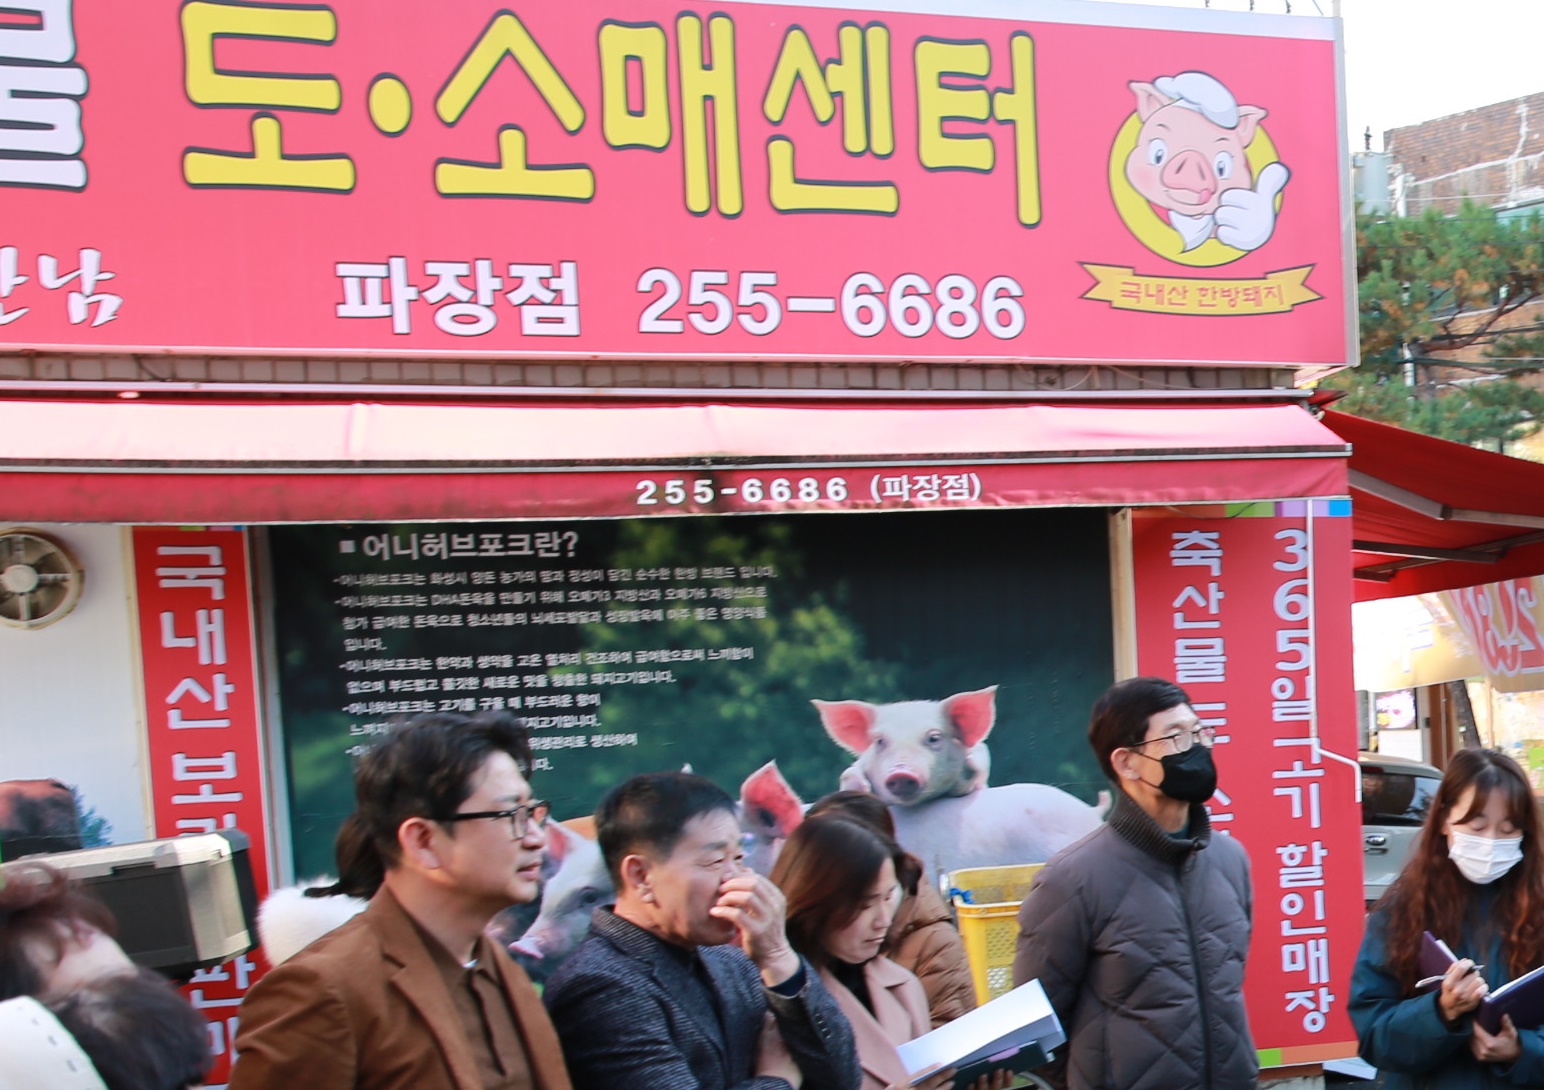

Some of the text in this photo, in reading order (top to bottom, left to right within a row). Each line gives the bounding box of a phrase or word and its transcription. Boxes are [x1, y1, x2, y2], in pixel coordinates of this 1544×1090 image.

[335, 257, 1025, 340] 파장점 255-6686
[1119, 281, 1286, 308] 국내산 한방돼지
[635, 472, 982, 505] 255-6686 (파장점)
[362, 530, 579, 560] 어니허브포크란?
[156, 545, 235, 730] 국내산
[1169, 529, 1227, 684] 축산물
[1272, 527, 1334, 1034] 365일 고기 할인매장
